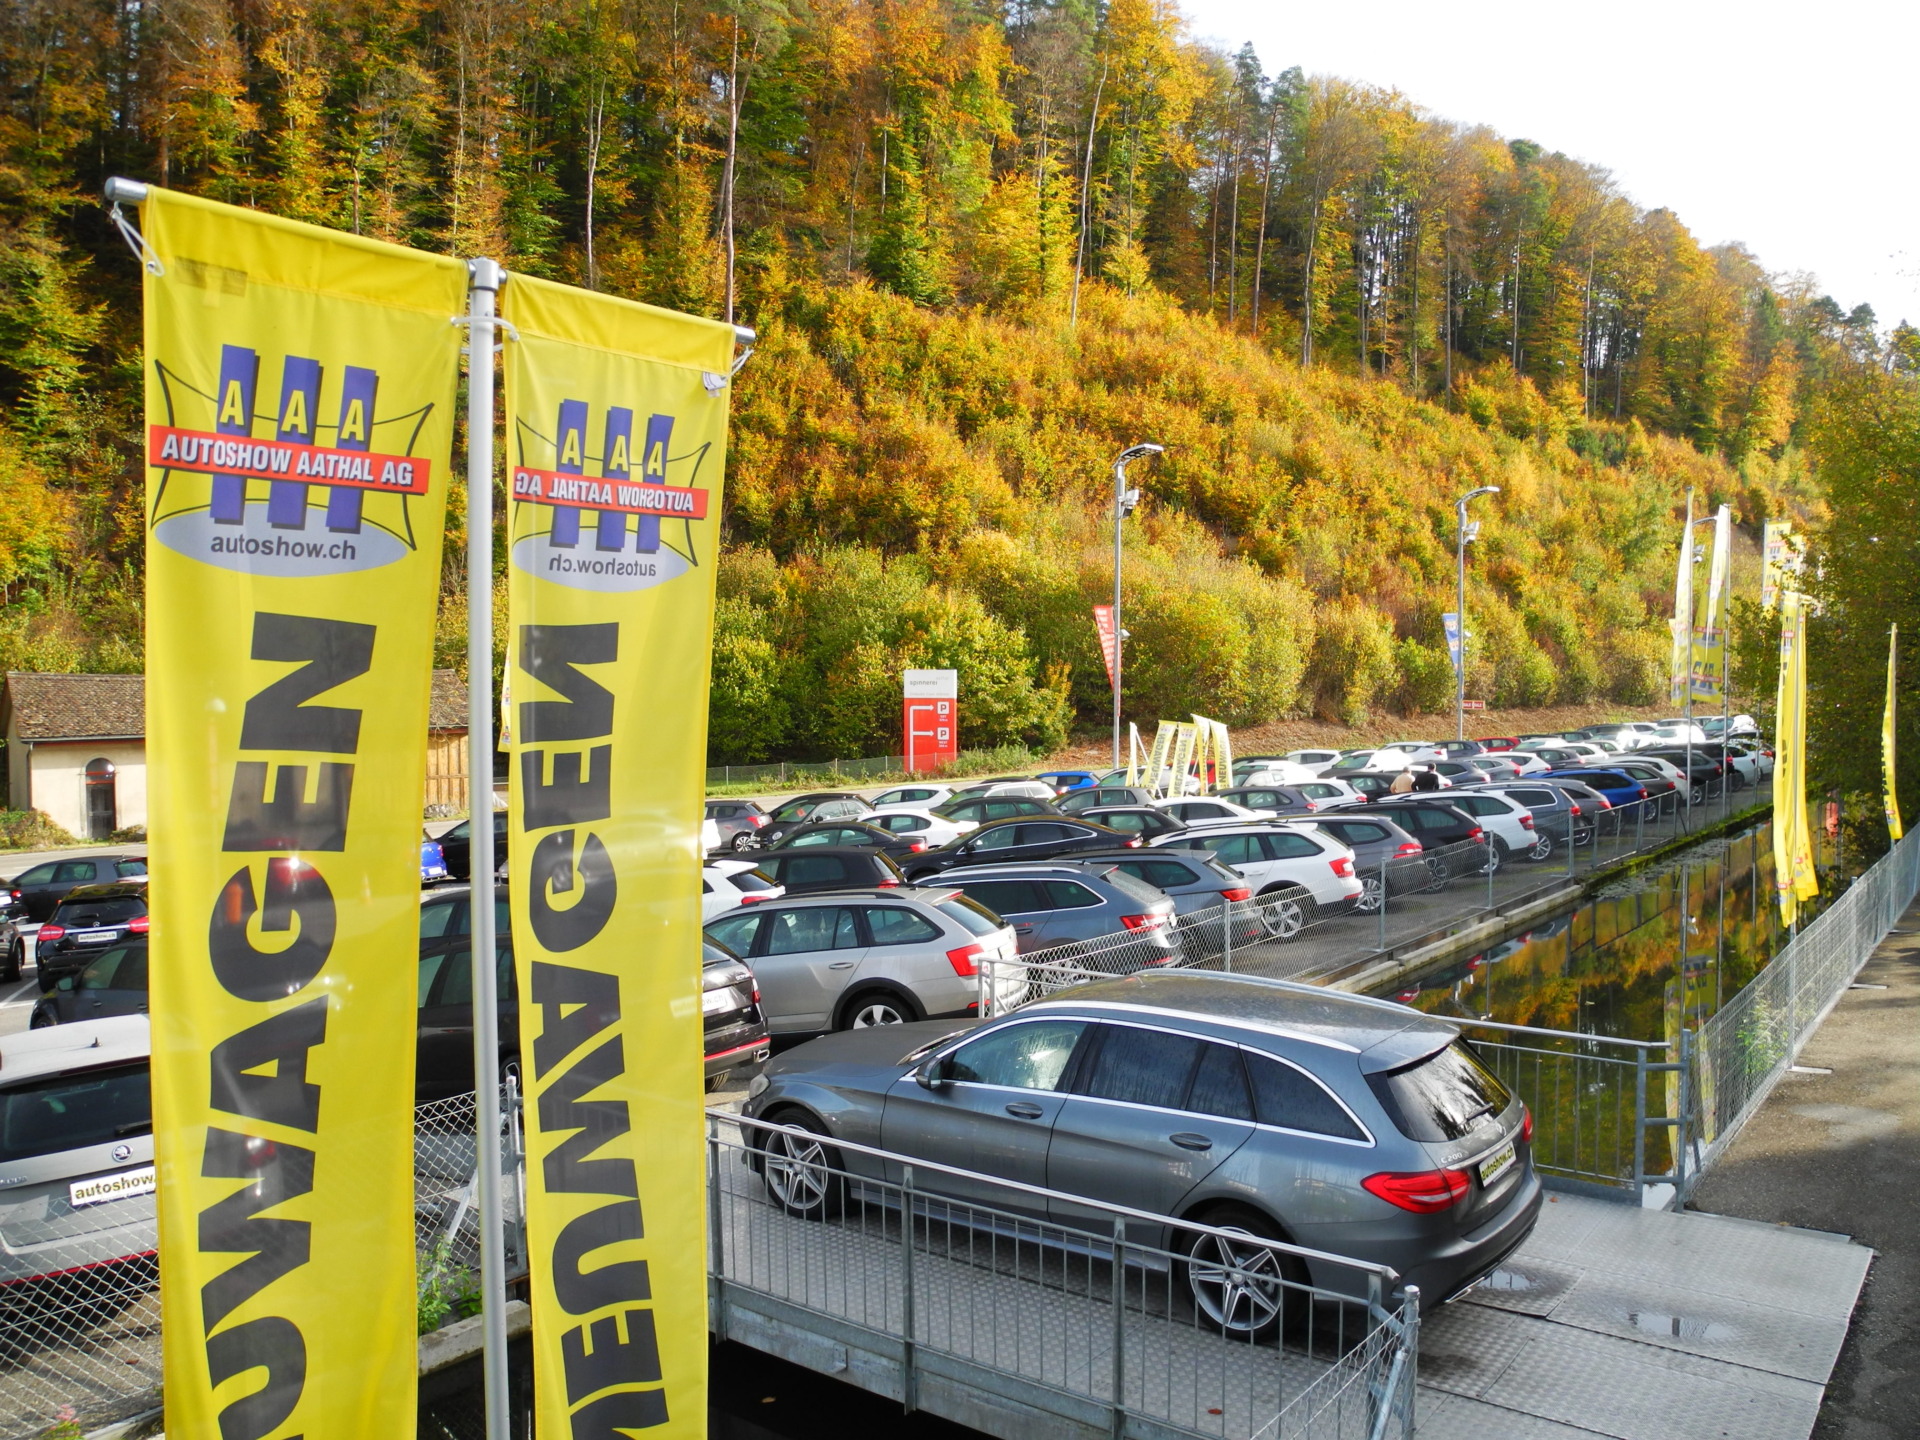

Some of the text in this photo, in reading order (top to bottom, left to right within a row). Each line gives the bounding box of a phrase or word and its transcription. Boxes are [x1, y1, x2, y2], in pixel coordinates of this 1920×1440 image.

[219, 380, 365, 442] A A A
[161, 434, 414, 486] AUTOSHOW AATHAL AG
[210, 535, 356, 560] autoshow.ch
[198, 611, 377, 1440] UWAGEN
[1447, 1152, 1463, 1162] 200
[1481, 1146, 1514, 1179] autoshow.ch
